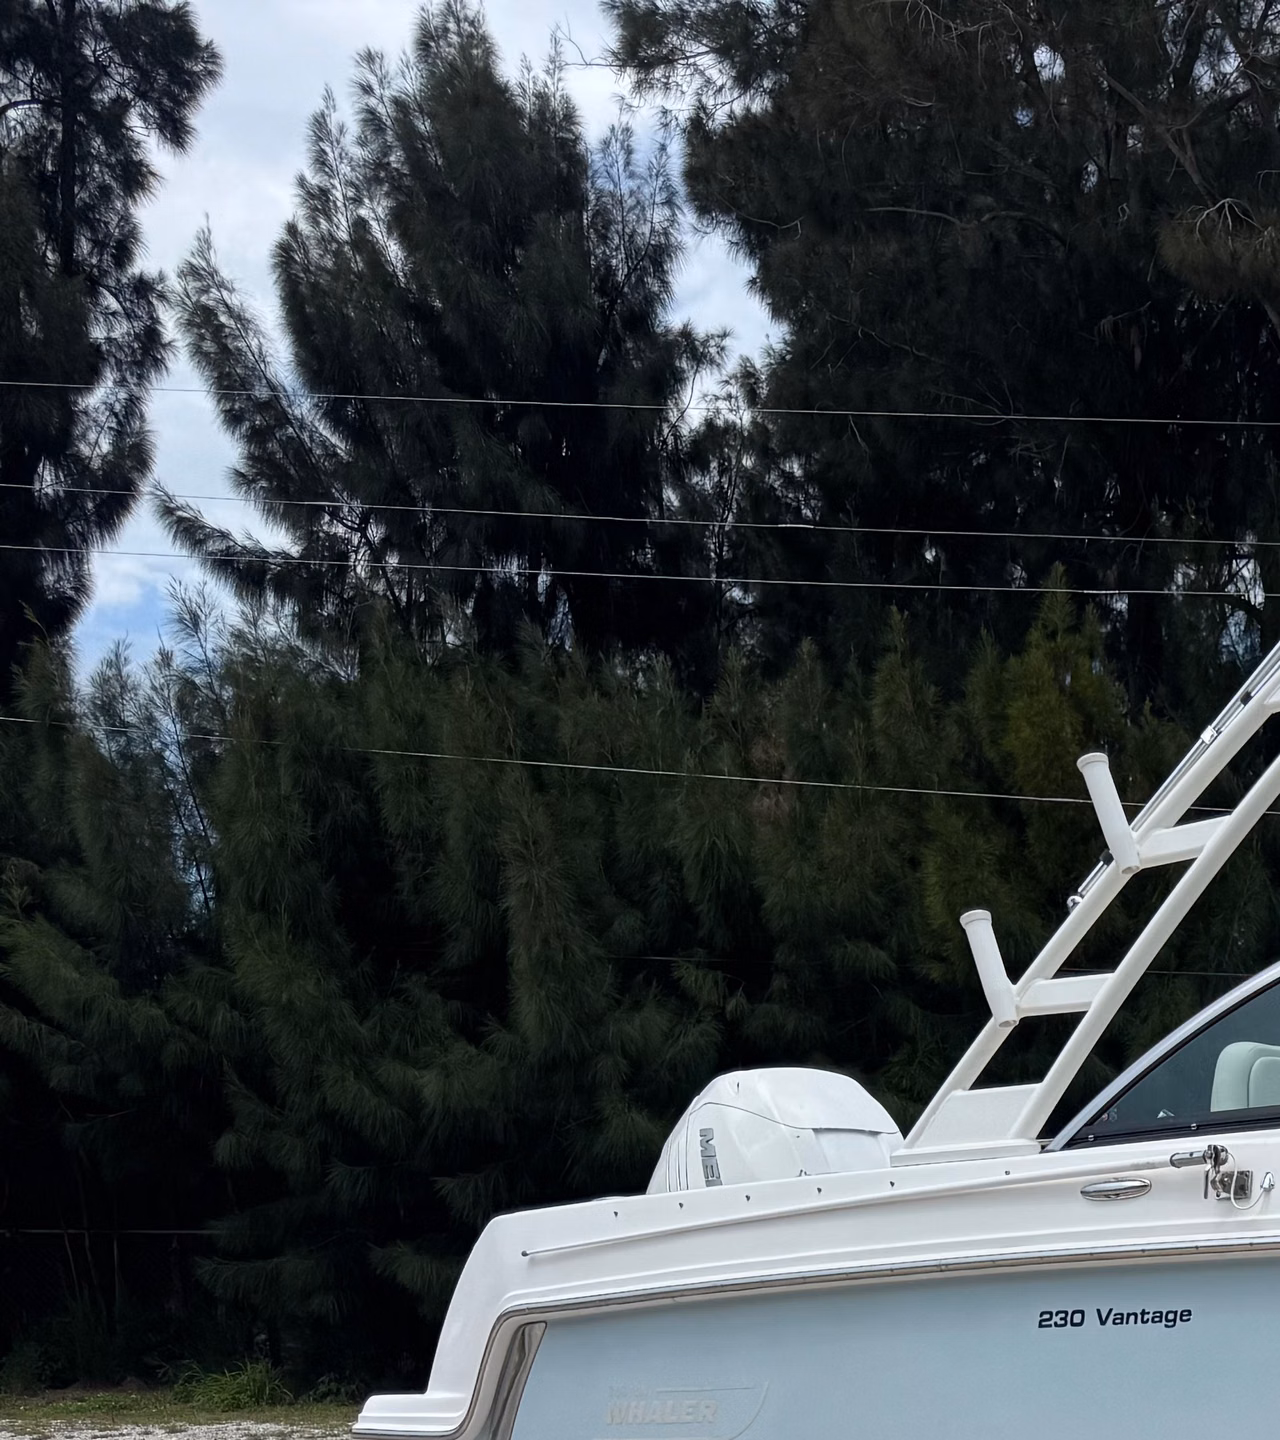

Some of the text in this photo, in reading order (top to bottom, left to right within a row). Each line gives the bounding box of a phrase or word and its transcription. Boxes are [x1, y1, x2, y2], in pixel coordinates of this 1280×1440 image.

[1037, 1307, 1193, 1329] 230 Vantage
[606, 1400, 718, 1425] WHALER
